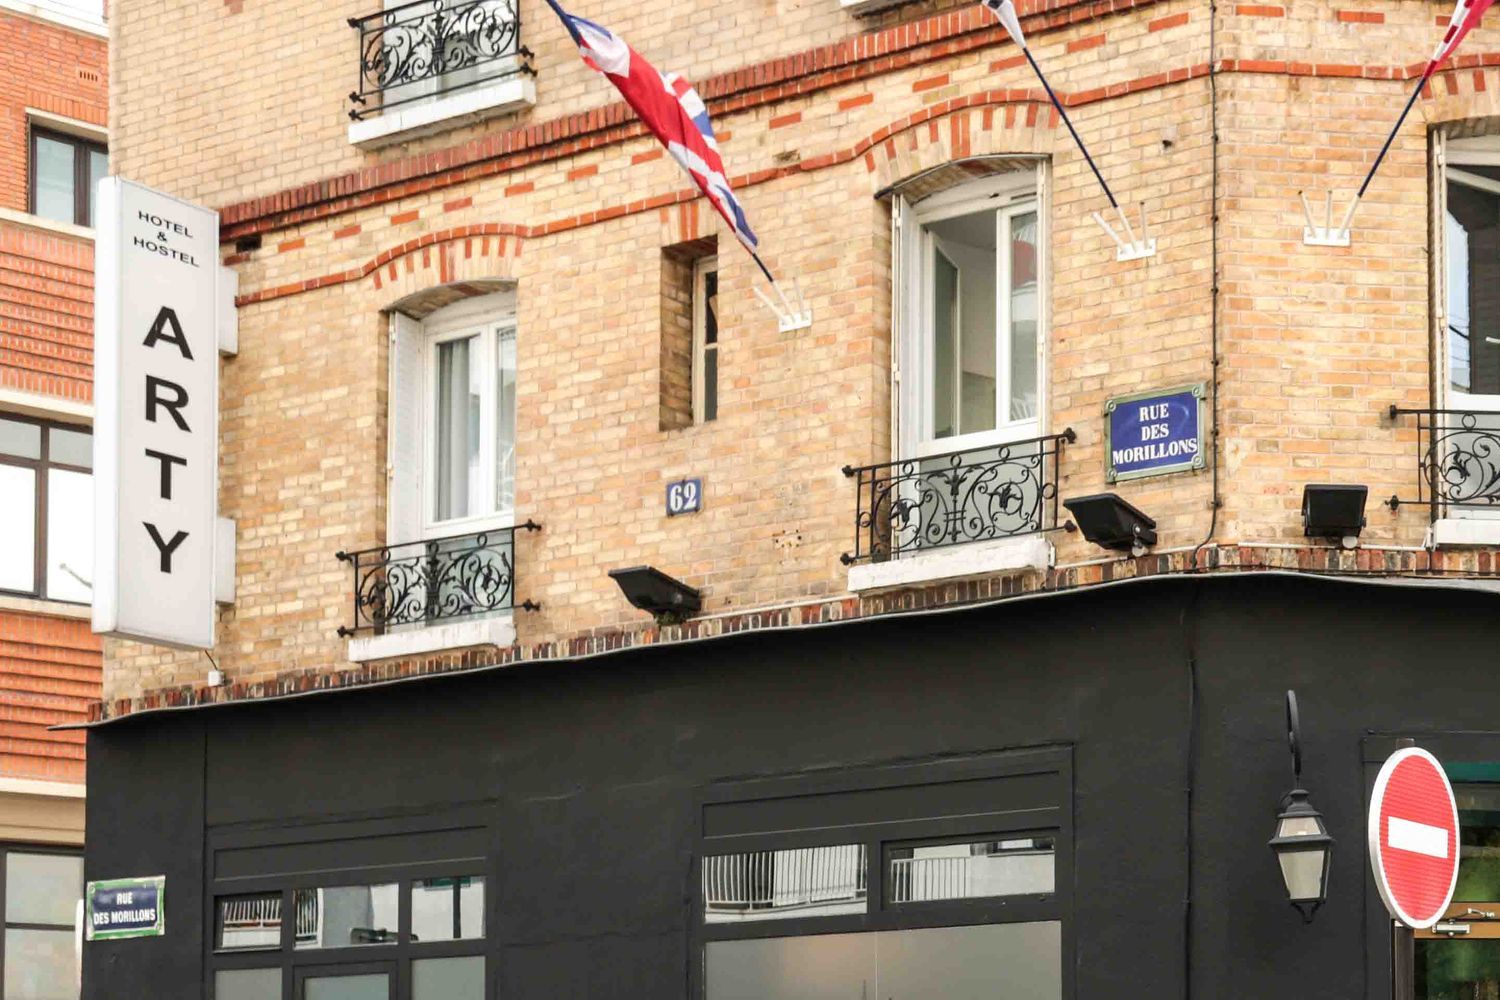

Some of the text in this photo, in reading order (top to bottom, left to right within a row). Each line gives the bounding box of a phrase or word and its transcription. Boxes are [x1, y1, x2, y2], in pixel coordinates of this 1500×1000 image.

[138, 210, 194, 239] HOTEL
[157, 231, 167, 242] &
[133, 236, 200, 268] HOSTEL
[1139, 403, 1170, 421] RUE
[142, 305, 195, 574] ARTY
[1141, 423, 1170, 441] DES
[1112, 438, 1198, 466] MORILLONS
[670, 482, 697, 512] 62
[116, 891, 134, 905] RUE
[93, 908, 156, 925] DES MORILLONS
